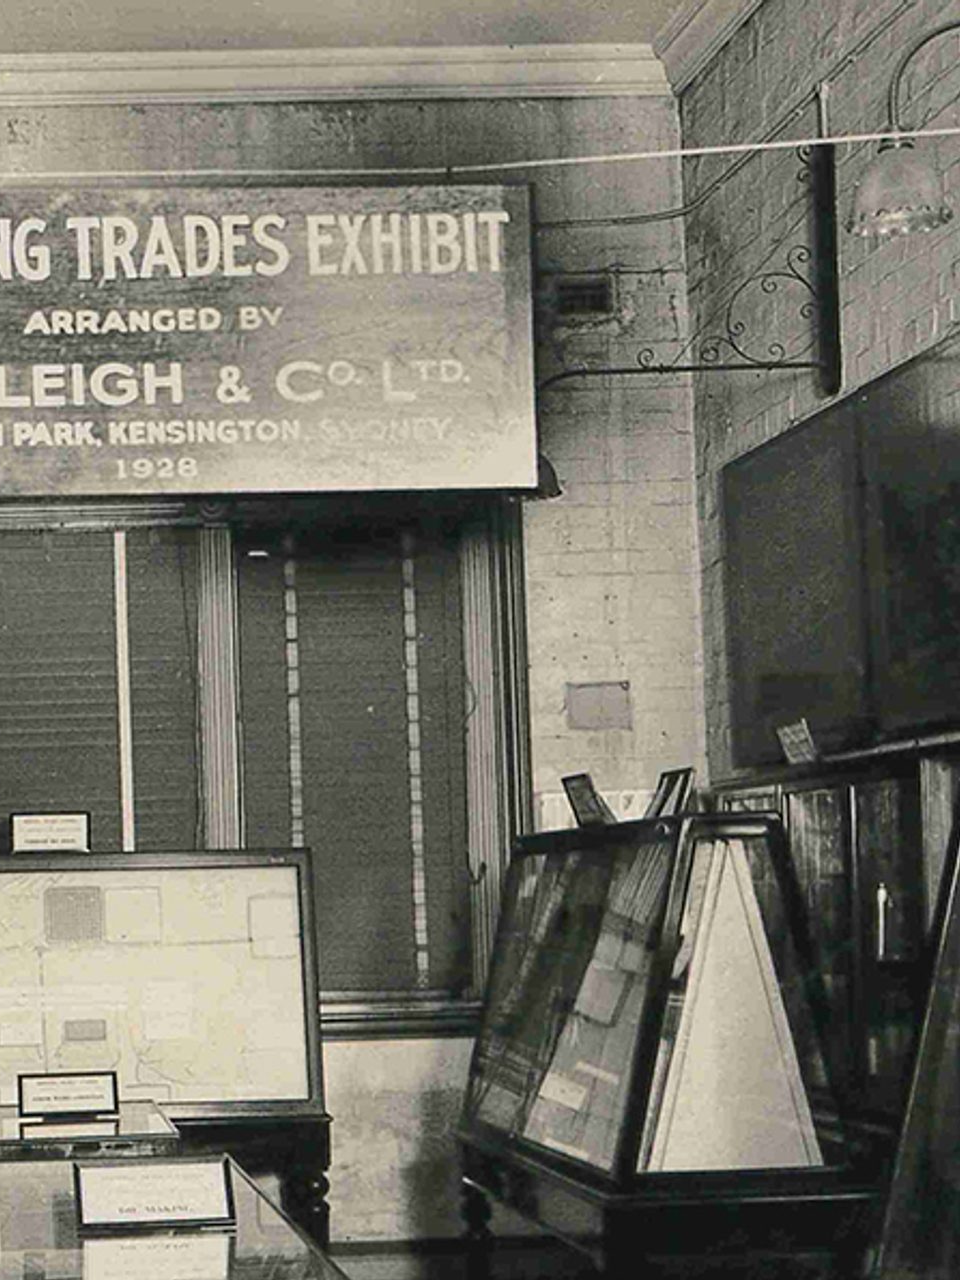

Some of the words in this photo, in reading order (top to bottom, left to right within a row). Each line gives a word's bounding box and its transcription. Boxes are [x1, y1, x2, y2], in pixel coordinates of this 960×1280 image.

[66, 214, 290, 280] TRADES
[306, 211, 510, 275] EXHIBIT
[23, 307, 222, 335] ARRANGED
[239, 306, 283, 331] BY
[216, 365, 252, 404] &
[12, 421, 102, 447] PARK,
[116, 458, 198, 480] 1928
